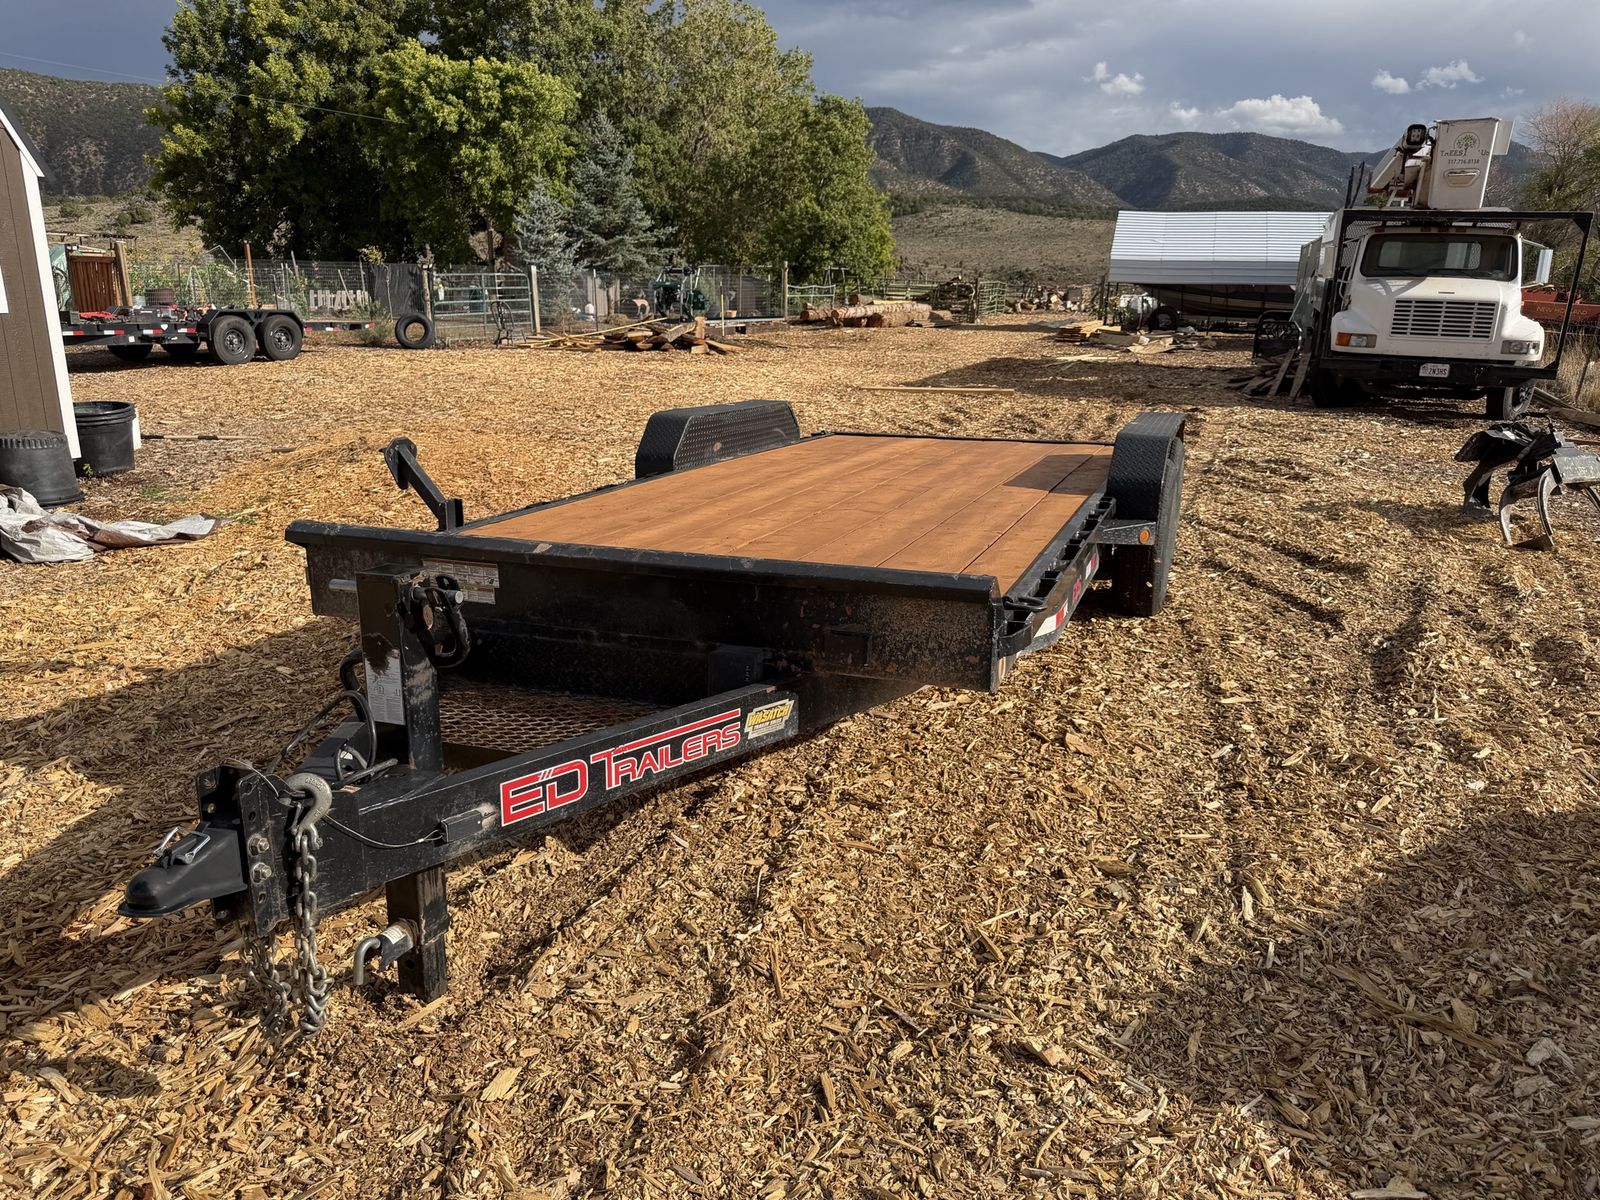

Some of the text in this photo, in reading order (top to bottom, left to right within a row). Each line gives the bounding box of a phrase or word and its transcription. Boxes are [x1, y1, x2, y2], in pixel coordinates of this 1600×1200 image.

[748, 703, 791, 727] WASATCH
[501, 708, 741, 827] ED TRAILERS
